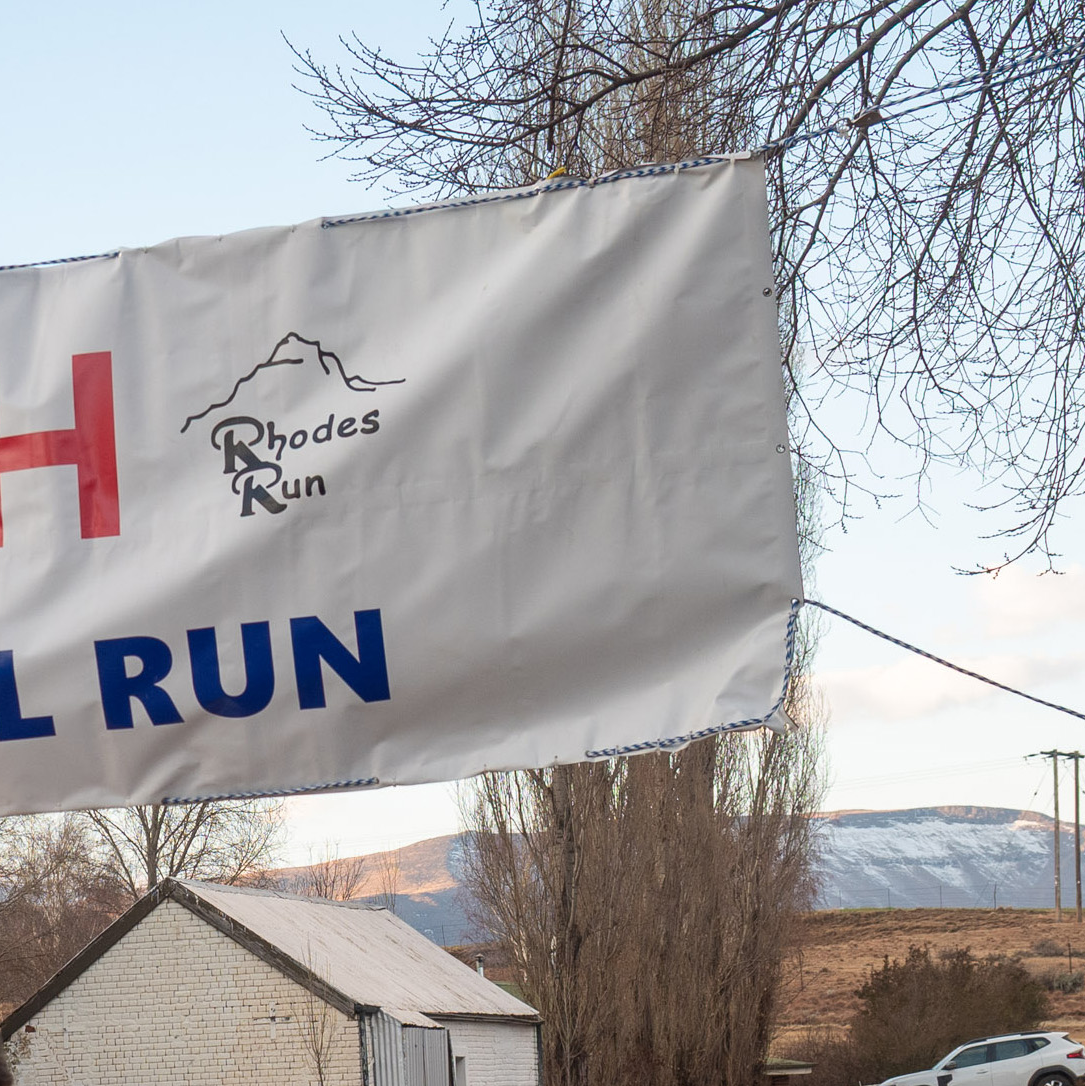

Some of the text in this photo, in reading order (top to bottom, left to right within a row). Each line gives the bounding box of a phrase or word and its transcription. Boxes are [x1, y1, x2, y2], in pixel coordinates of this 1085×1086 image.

[211, 409, 381, 475] Rhodes
[231, 464, 326, 518] Run
[94, 608, 391, 731] RUN
